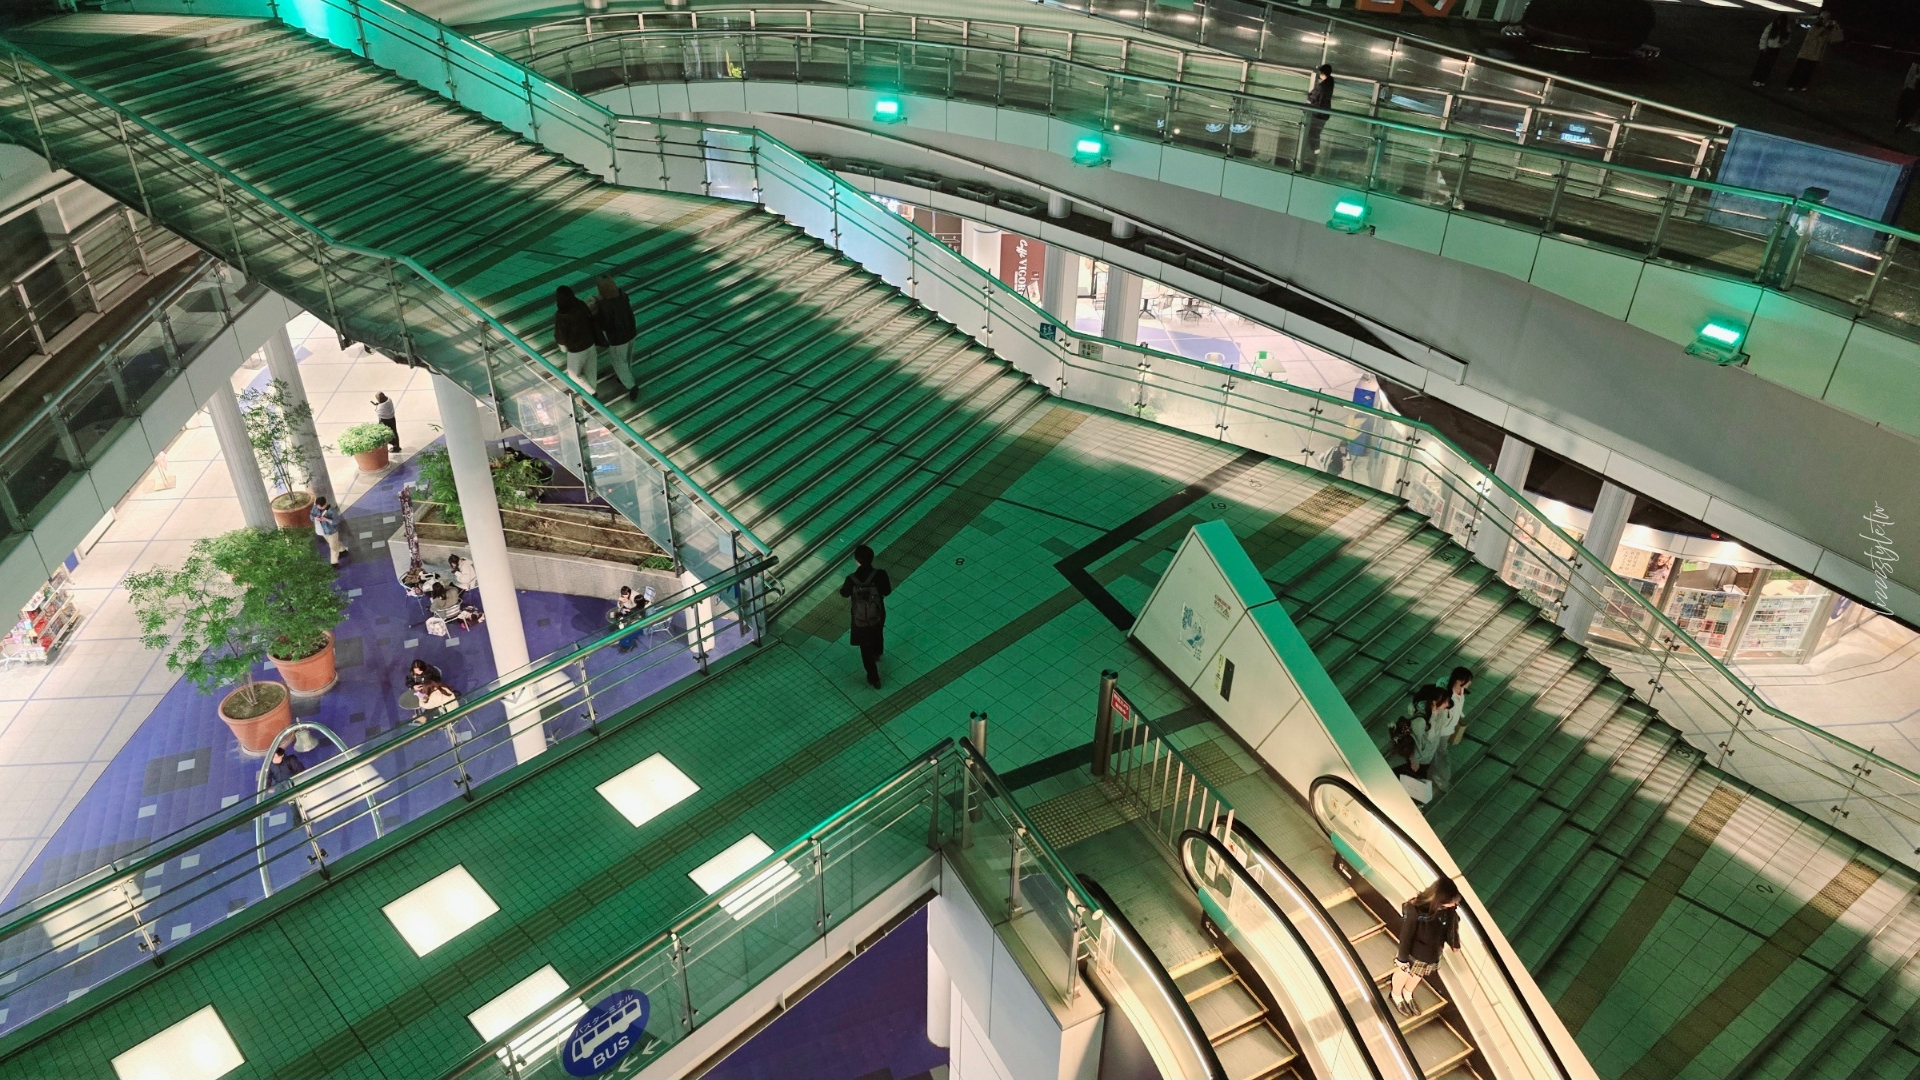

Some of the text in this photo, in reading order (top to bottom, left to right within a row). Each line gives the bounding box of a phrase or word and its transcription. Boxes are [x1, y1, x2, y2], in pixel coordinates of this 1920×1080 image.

[955, 557, 966, 566] 8
[1440, 551, 1456, 562] 40
[1675, 744, 1694, 759] 30
[1755, 884, 1774, 894] 2
[575, 994, 634, 1038] バスターミナル
[592, 1035, 630, 1070] BUS
